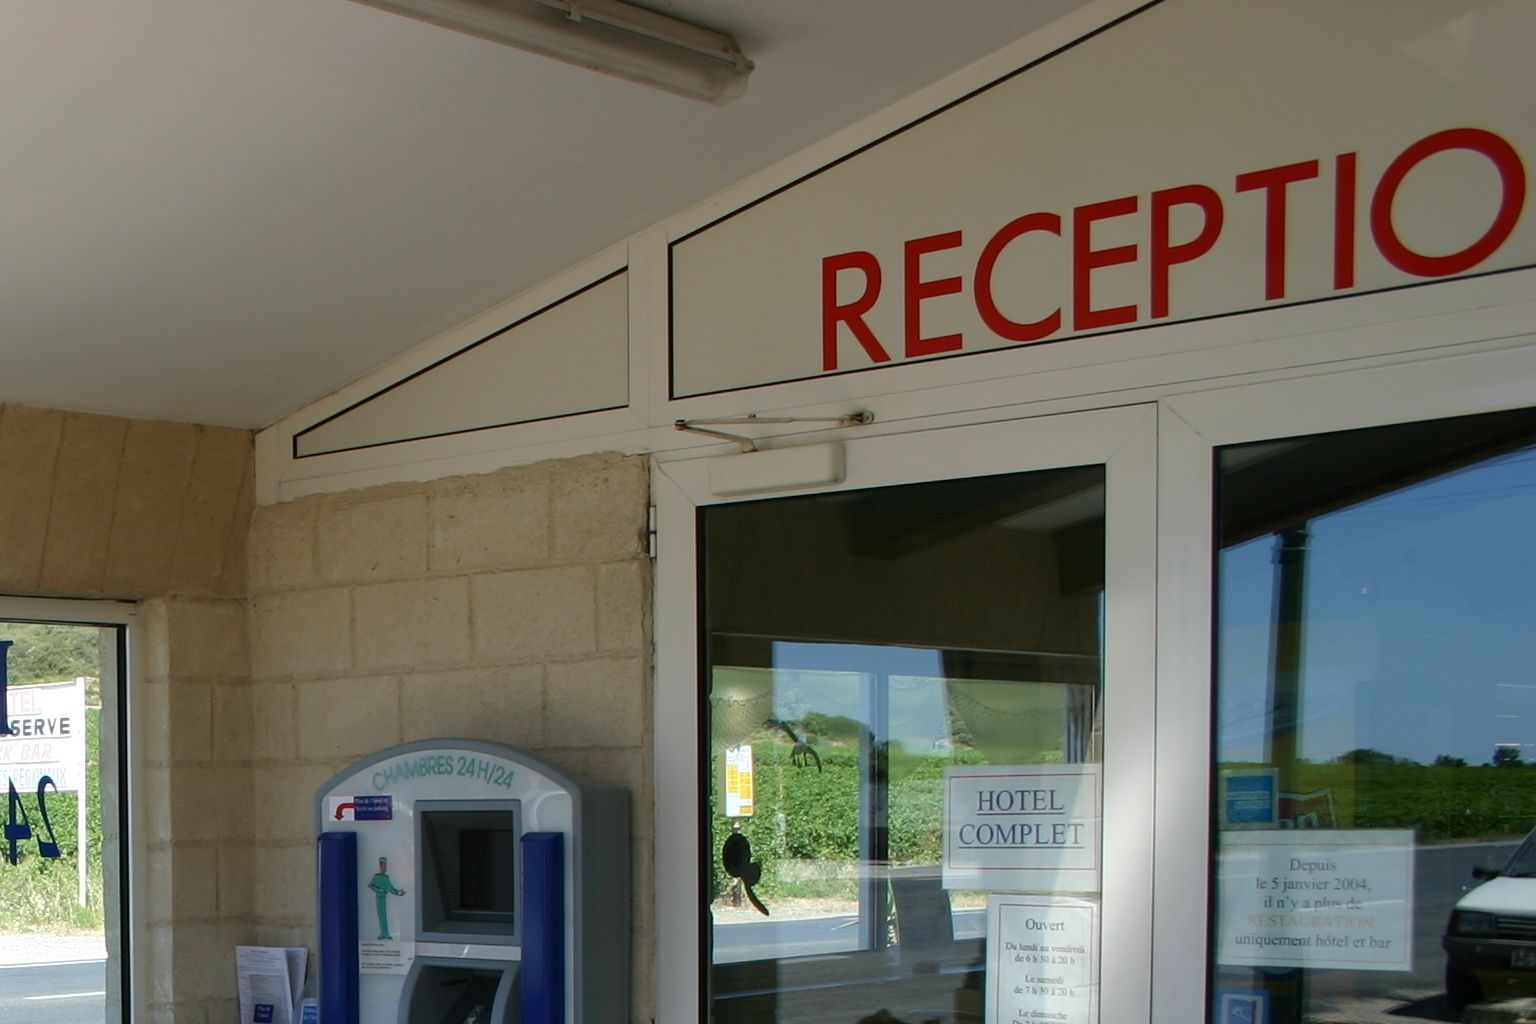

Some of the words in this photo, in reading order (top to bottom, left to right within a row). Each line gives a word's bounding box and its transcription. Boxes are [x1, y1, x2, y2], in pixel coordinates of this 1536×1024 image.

[822, 127, 1527, 371] RECEPTIO
[21, 742, 53, 761] BAR
[372, 756, 453, 790] CHAMBRES
[977, 789, 1065, 811] HOTEL
[959, 823, 1085, 845] COMPLET
[1289, 858, 1337, 874] Depuis
[1256, 877, 1267, 890] le
[1271, 877, 1279, 890] 5
[1281, 878, 1329, 893] janvier
[1264, 896, 1273, 909] il
[1302, 900, 1310, 908] a
[1314, 896, 1342, 911] plus
[1346, 898, 1363, 910] de
[1025, 918, 1065, 932] Ouvert
[1005, 941, 1017, 951] Du
[1019, 942, 1038, 952] lundi
[1051, 943, 1086, 954] vendredi
[1234, 934, 1311, 948] uniquement
[1315, 934, 1348, 948] hôtel
[1352, 937, 1366, 949] et
[1369, 936, 1392, 949] bar
[1014, 954, 1025, 963] de
[1032, 954, 1038, 963] h
[1069, 956, 1076, 965] h
[1025, 974, 1035, 983] Le
[1036, 975, 1064, 985] samedi
[1013, 985, 1024, 994] de
[1024, 986, 1031, 994] 7
[1031, 986, 1038, 995] h
[1068, 988, 1075, 997] h
[1018, 1008, 1029, 1017] Le
[1030, 1009, 1068, 1020] dimanche
